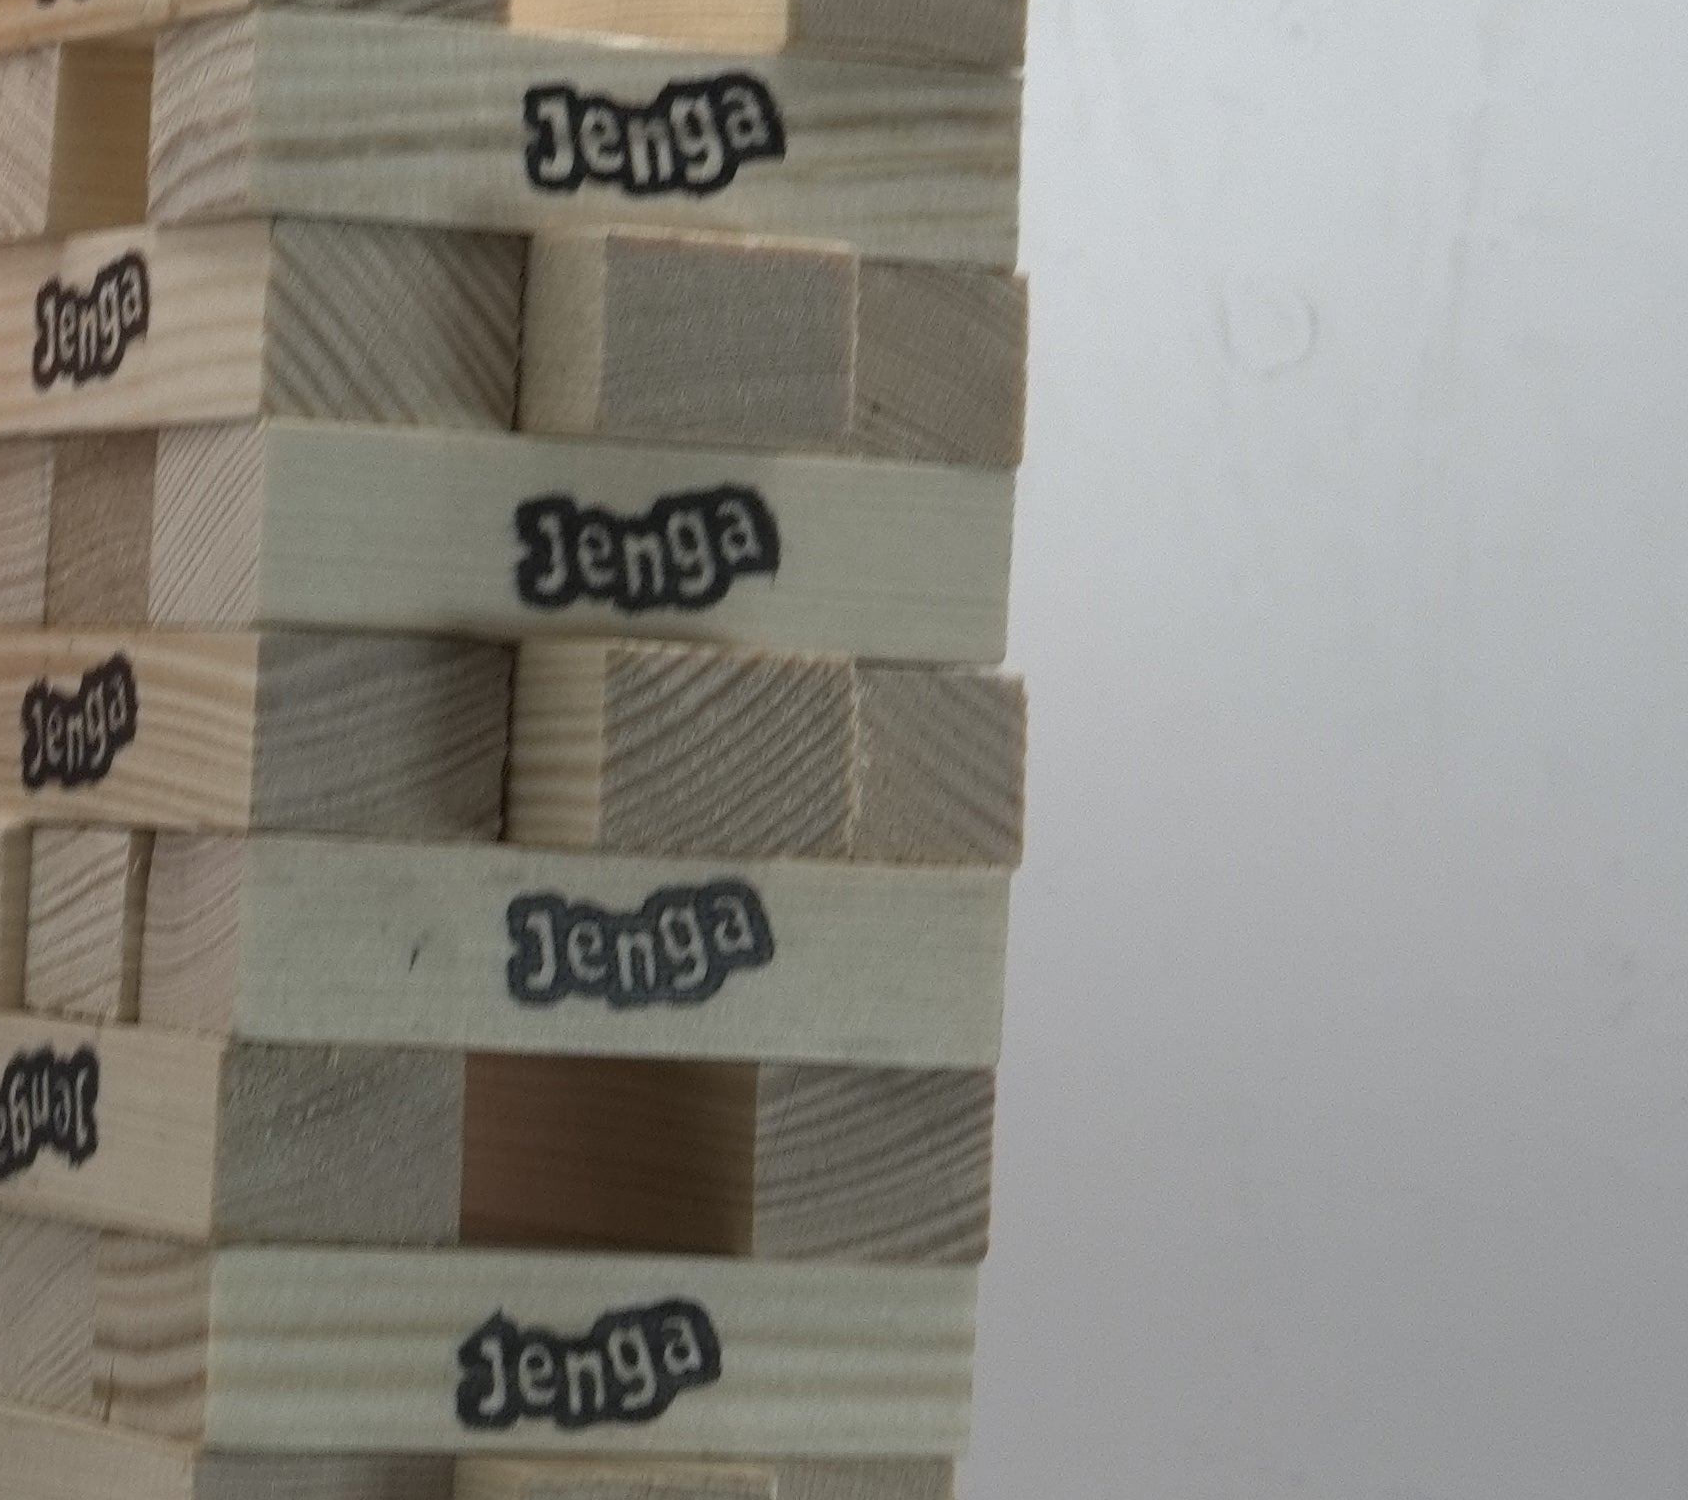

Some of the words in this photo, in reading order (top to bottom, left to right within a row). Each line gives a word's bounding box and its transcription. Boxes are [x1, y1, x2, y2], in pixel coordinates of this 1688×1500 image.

[528, 78, 778, 185] Jenga
[35, 255, 147, 385] Jenga
[524, 491, 771, 605] Jenga
[25, 662, 134, 784] Jenga
[514, 886, 766, 1000] Jenga
[465, 1306, 712, 1422] Jenga
